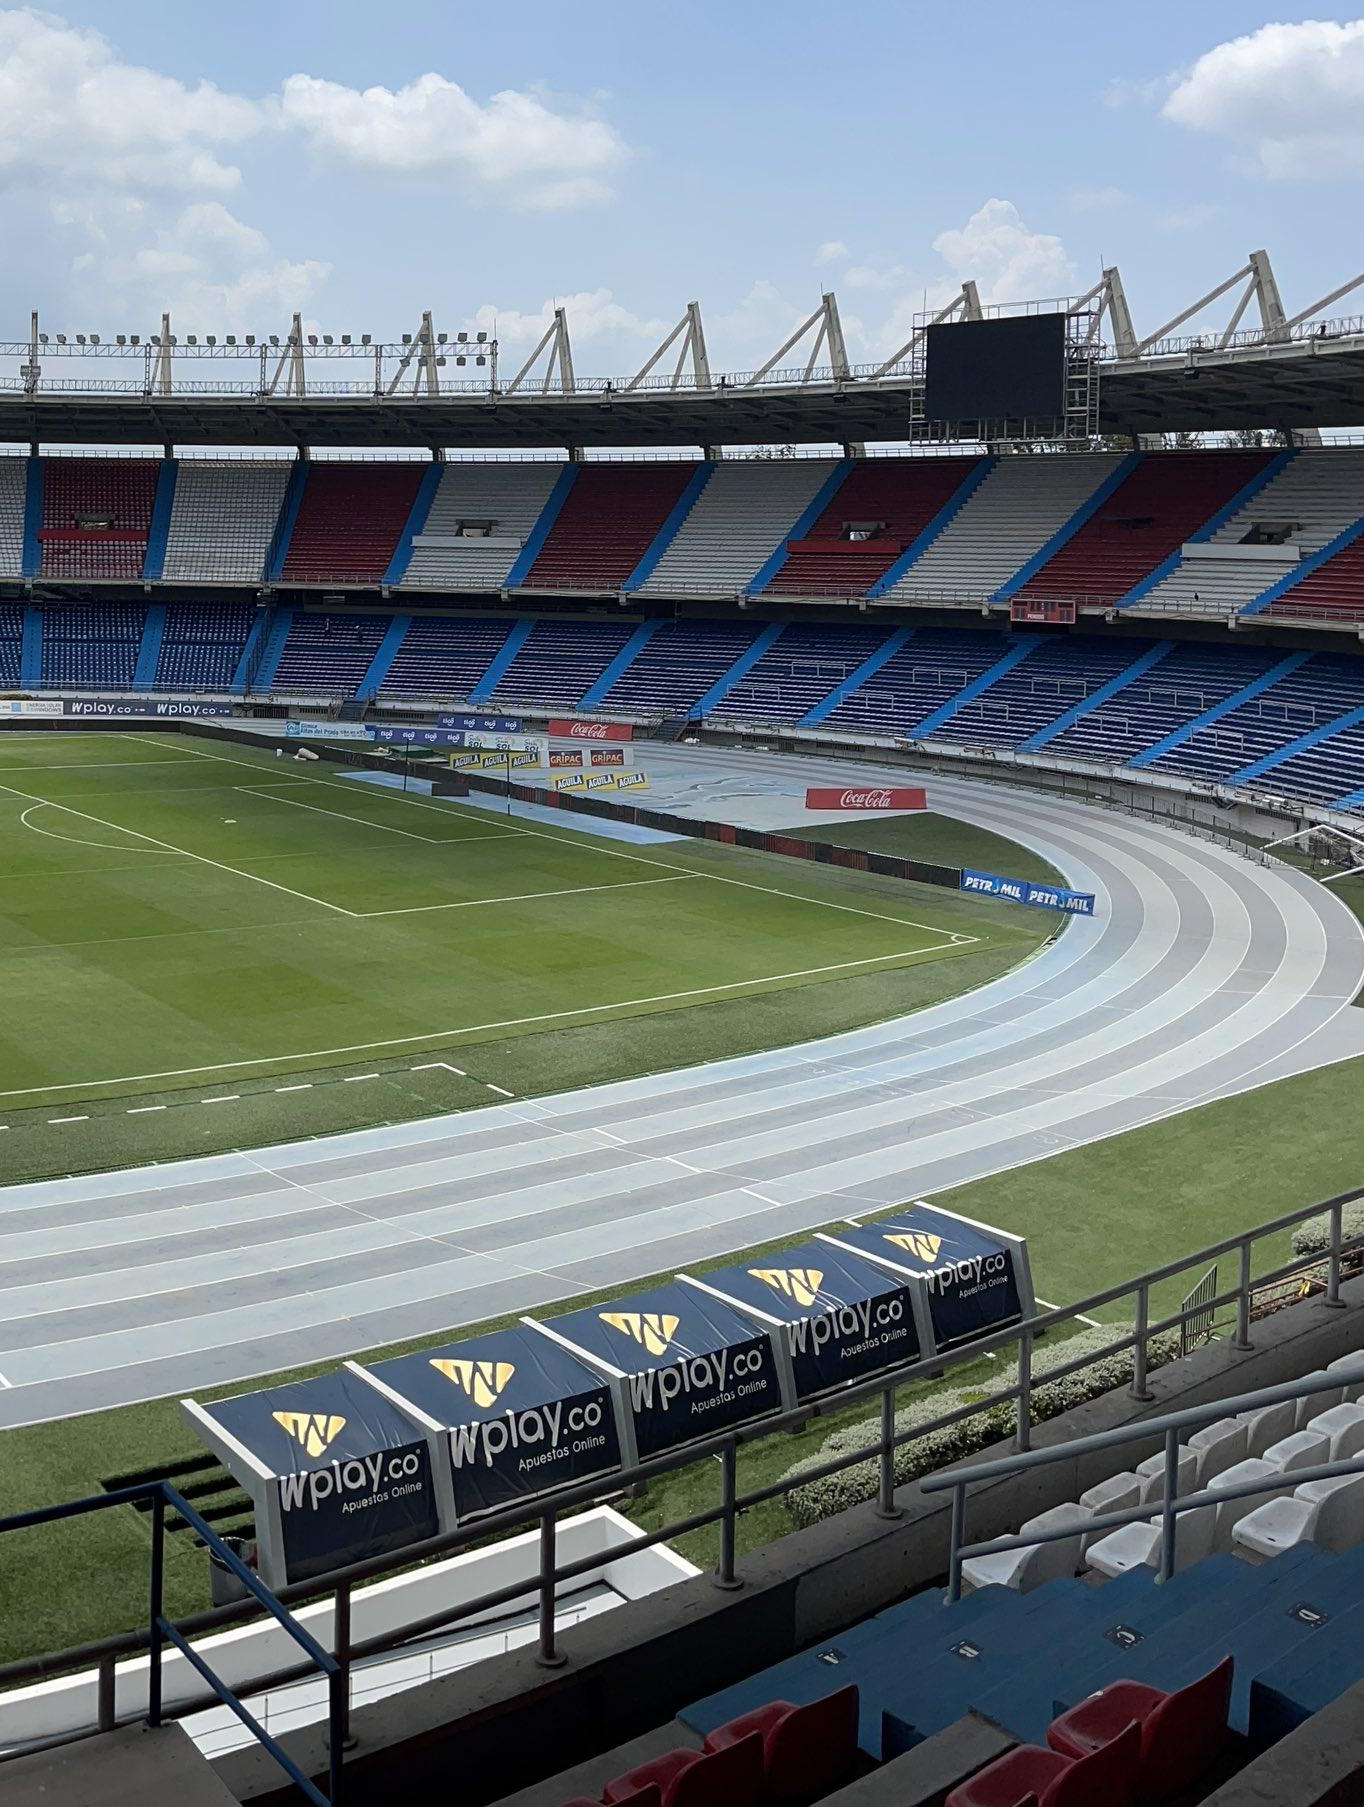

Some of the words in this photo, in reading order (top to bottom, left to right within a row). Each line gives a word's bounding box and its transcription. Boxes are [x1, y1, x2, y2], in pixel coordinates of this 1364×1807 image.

[840, 1337, 879, 1359] Apuestas
[880, 1327, 907, 1343] Online
[691, 1391, 736, 1414] Apuestas
[738, 1378, 768, 1398] Online
[518, 1449, 569, 1473] Apuestas
[573, 1433, 606, 1455] Online
[341, 1491, 389, 1514] Apuestas
[391, 1481, 422, 1498] Online
